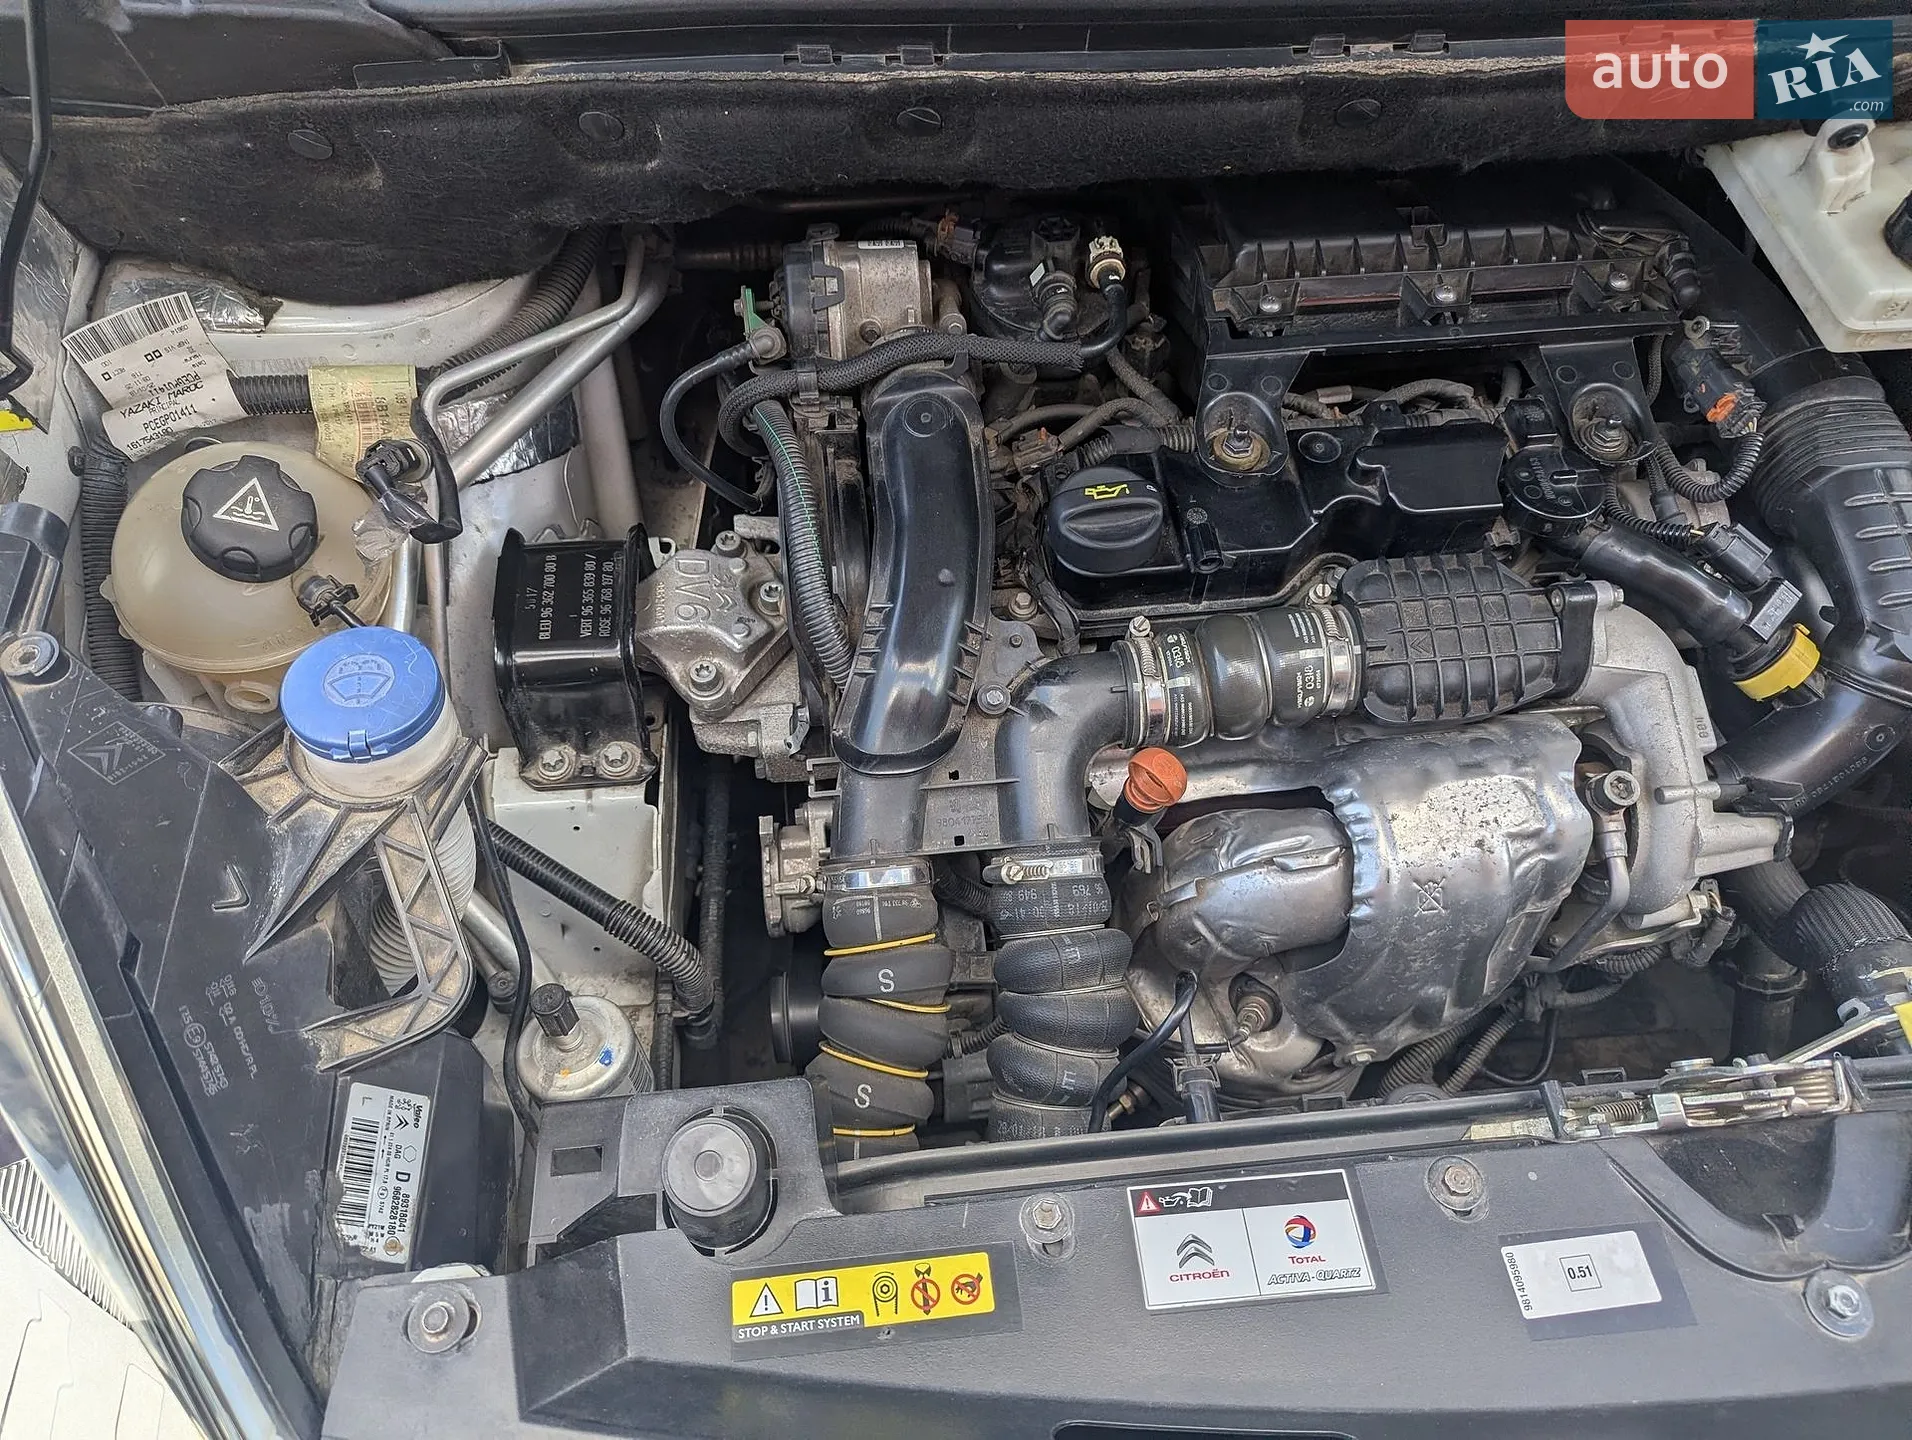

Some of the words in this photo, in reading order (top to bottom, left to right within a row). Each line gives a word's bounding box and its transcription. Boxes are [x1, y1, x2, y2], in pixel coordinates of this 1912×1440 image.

[120, 395, 161, 418] YAZAKI
[168, 380, 204, 401] MAROC
[143, 404, 197, 432] PCEGP01411
[543, 574, 556, 589] 700
[583, 573, 595, 587] 839
[602, 574, 613, 586] 197
[542, 590, 555, 605] 362
[582, 589, 595, 604] 365
[601, 588, 613, 603] 768
[672, 558, 711, 625] DV6
[541, 607, 552, 618] 96
[581, 606, 593, 616] 96
[600, 604, 612, 615] 96
[539, 620, 552, 640] BLEU
[580, 619, 592, 638] VERT
[598, 617, 611, 637] ROSE
[877, 968, 894, 992] S
[854, 1083, 871, 1108] S
[411, 1104, 423, 1129] Valeo
[393, 1143, 402, 1159] DAG
[394, 1170, 411, 1183] D
[385, 1185, 402, 1236] 9682828180
[395, 1192, 411, 1233] 89318041
[1505, 1252, 1533, 1311] 9814095980
[1567, 1265, 1593, 1280] 0.51
[738, 1327, 769, 1339] STOP
[770, 1325, 779, 1335] &
[780, 1319, 816, 1333] START
[817, 1315, 860, 1330] SYSTEM
